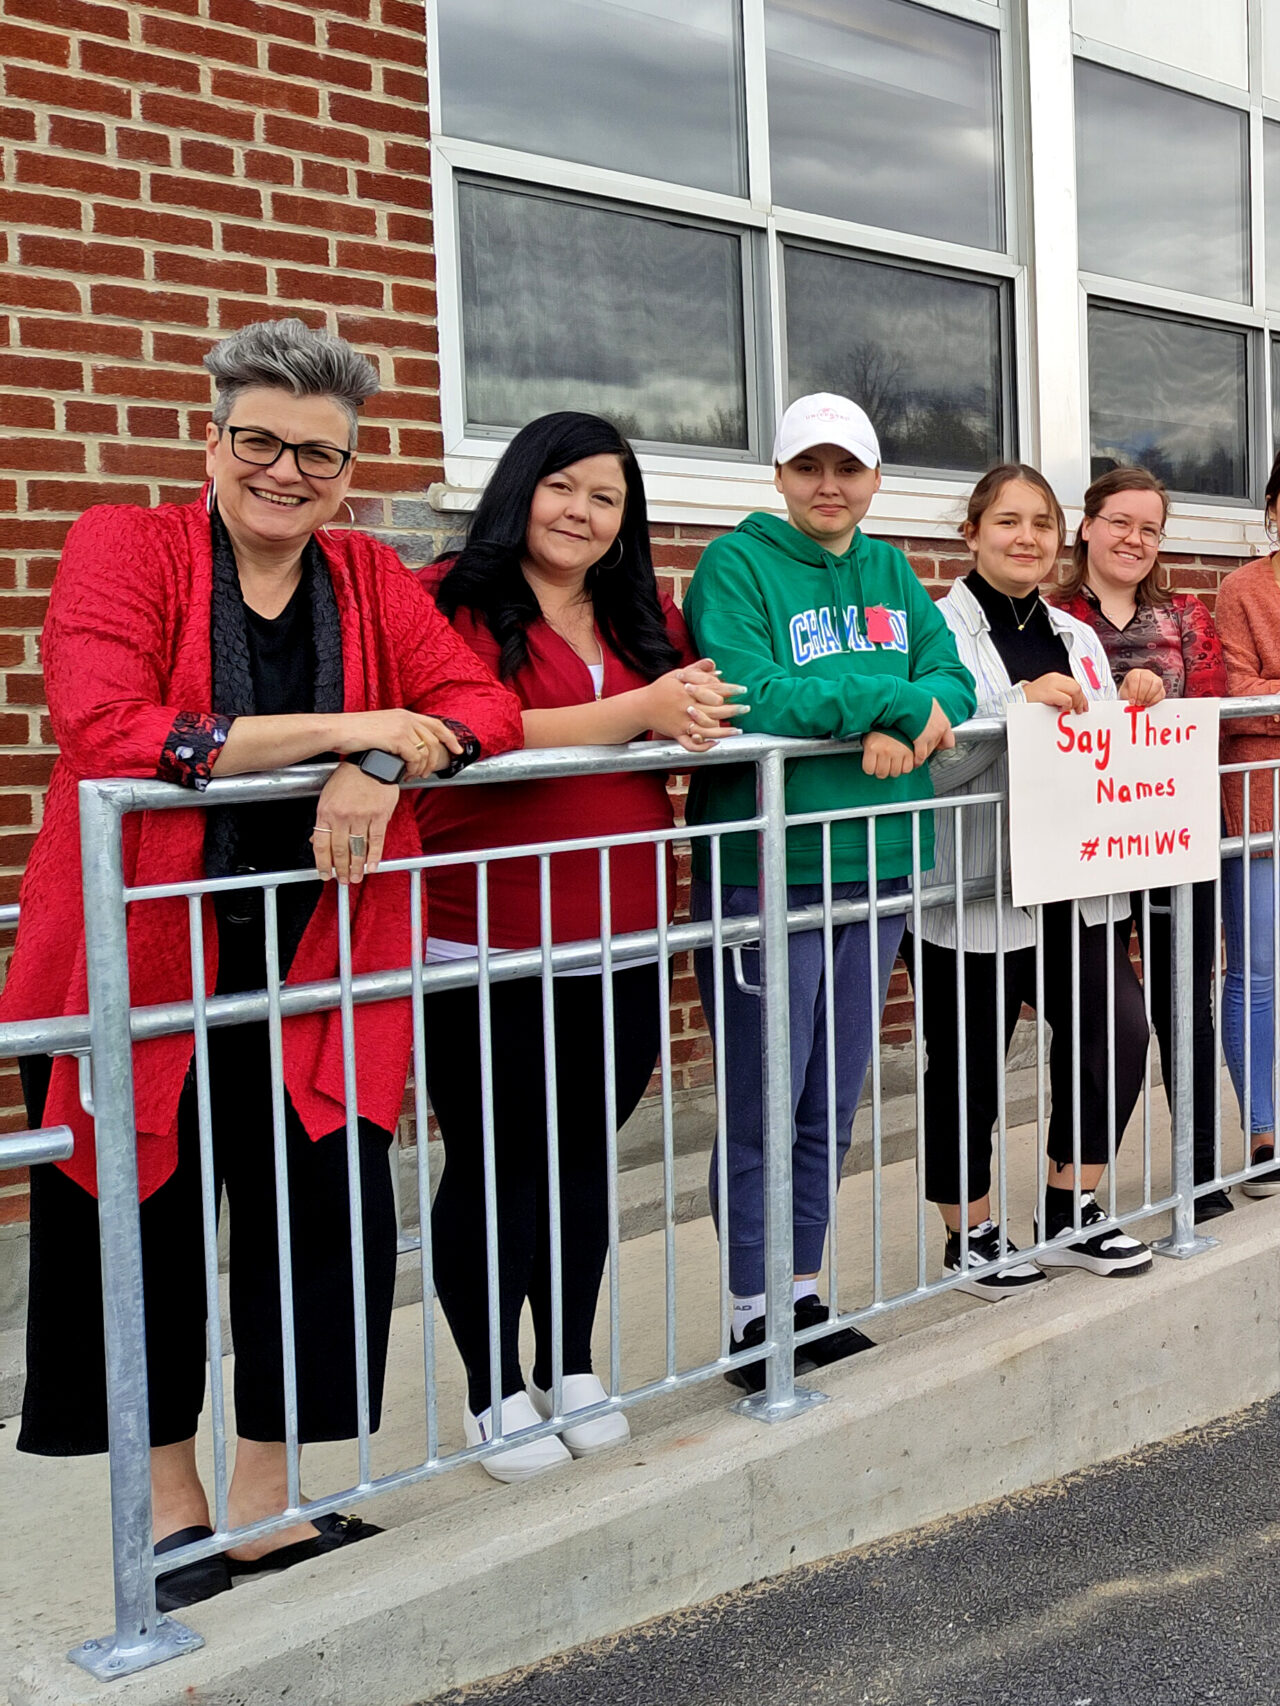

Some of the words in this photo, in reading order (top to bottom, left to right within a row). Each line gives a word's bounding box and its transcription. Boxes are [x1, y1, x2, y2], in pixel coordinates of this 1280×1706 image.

[1056, 710, 1111, 770] Say
[1123, 705, 1197, 747] Their
[1096, 777, 1176, 804] Names
[1080, 828, 1191, 861] #MMIWG
